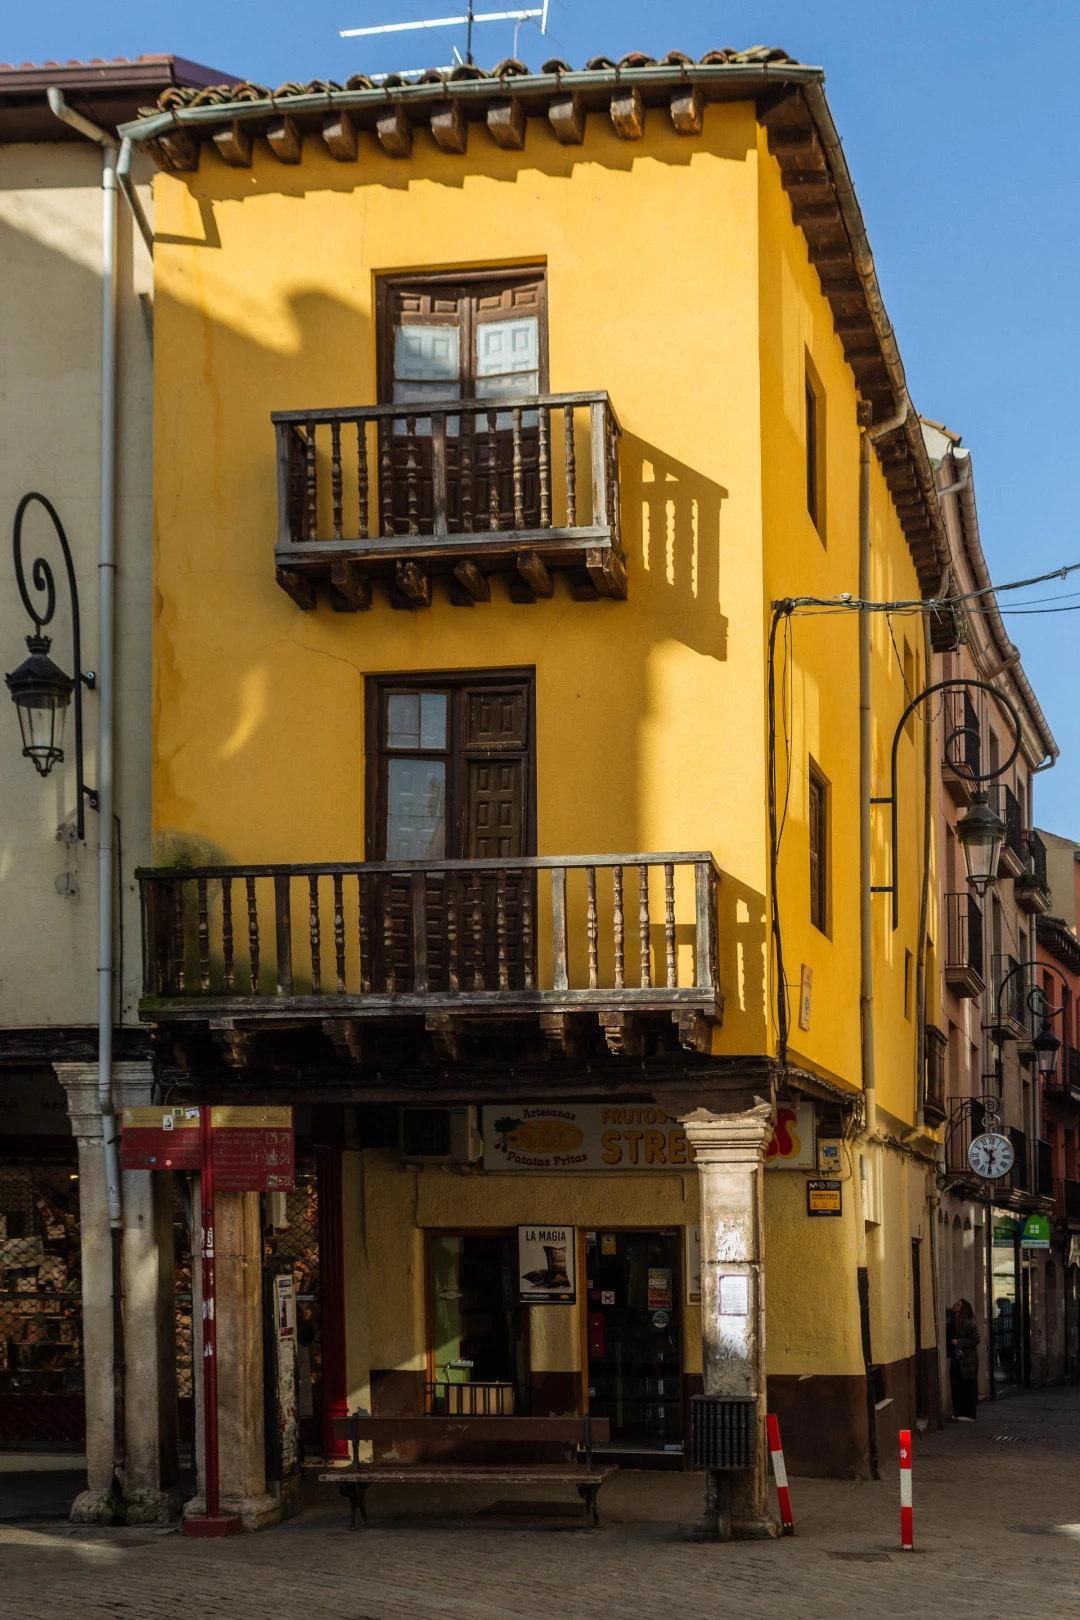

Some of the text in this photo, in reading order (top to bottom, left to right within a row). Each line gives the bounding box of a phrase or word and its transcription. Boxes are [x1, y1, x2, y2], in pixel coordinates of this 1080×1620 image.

[523, 1108, 576, 1121] Artesanas
[601, 1107, 668, 1125] FRUTOS
[601, 1130, 698, 1165] STRE
[507, 1151, 588, 1167] Patatas Fritas
[526, 1231, 567, 1242] LA MAGIA
